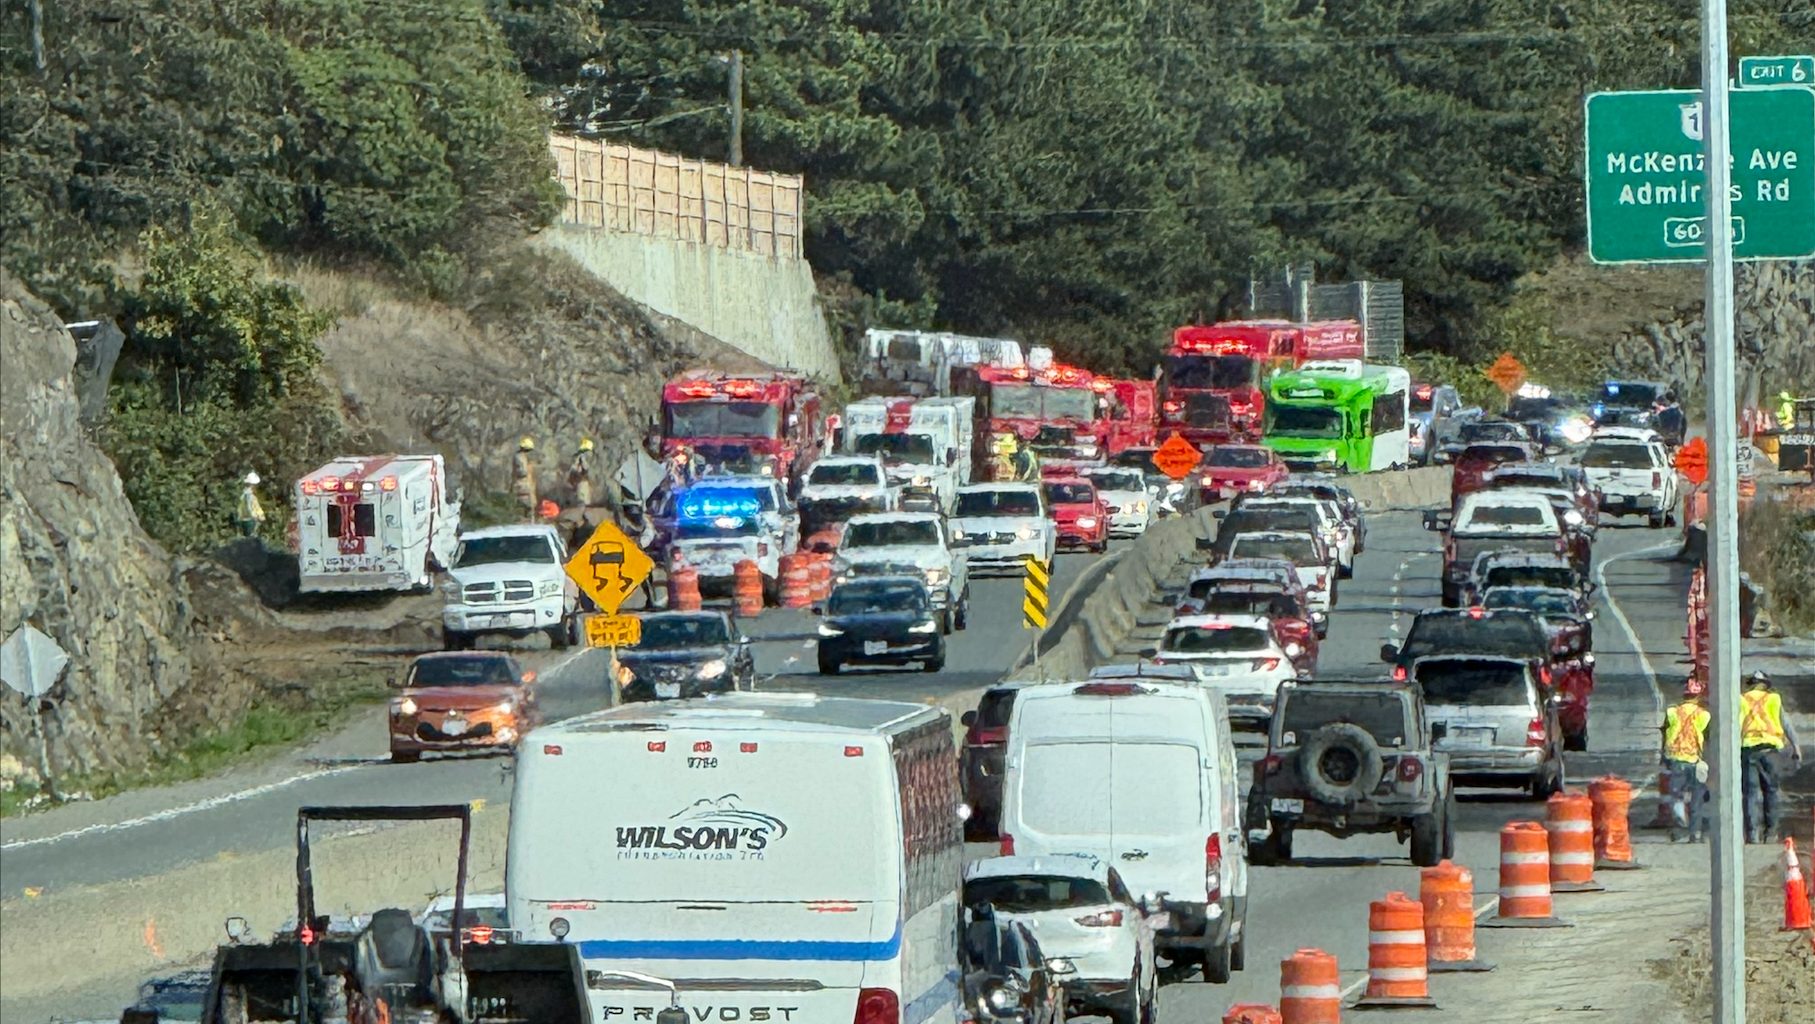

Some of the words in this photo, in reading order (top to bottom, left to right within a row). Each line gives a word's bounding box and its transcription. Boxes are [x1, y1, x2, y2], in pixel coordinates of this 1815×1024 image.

[1791, 61, 1806, 81] 6
[1688, 112, 1699, 132] 1
[1606, 150, 1735, 173] McKenz
[1749, 148, 1798, 170] Ave
[1618, 179, 1743, 205] Admirs
[1757, 177, 1790, 202] Rd
[1673, 223, 1704, 240] 60
[616, 826, 769, 850] WILSON'S
[603, 1006, 799, 1022] PRVOST
